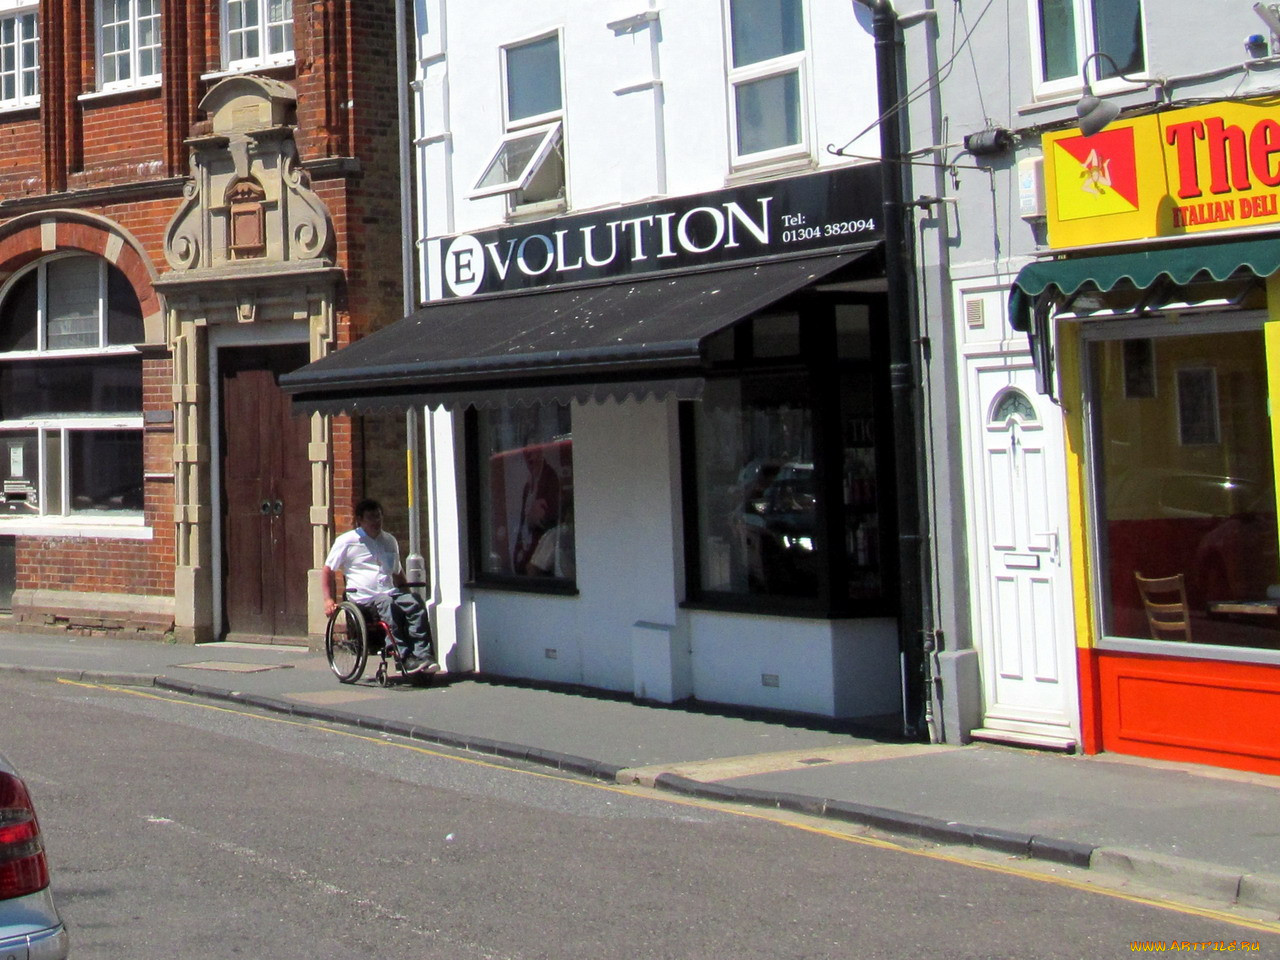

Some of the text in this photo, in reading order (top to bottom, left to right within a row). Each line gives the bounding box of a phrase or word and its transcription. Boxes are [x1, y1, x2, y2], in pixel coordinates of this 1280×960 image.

[1166, 116, 1280, 199] The
[781, 213, 806, 227] Tel:
[1172, 194, 1278, 228] ITALIAN DELI
[448, 197, 773, 294] EVOLUTION
[782, 218, 875, 243] 01304 382094
